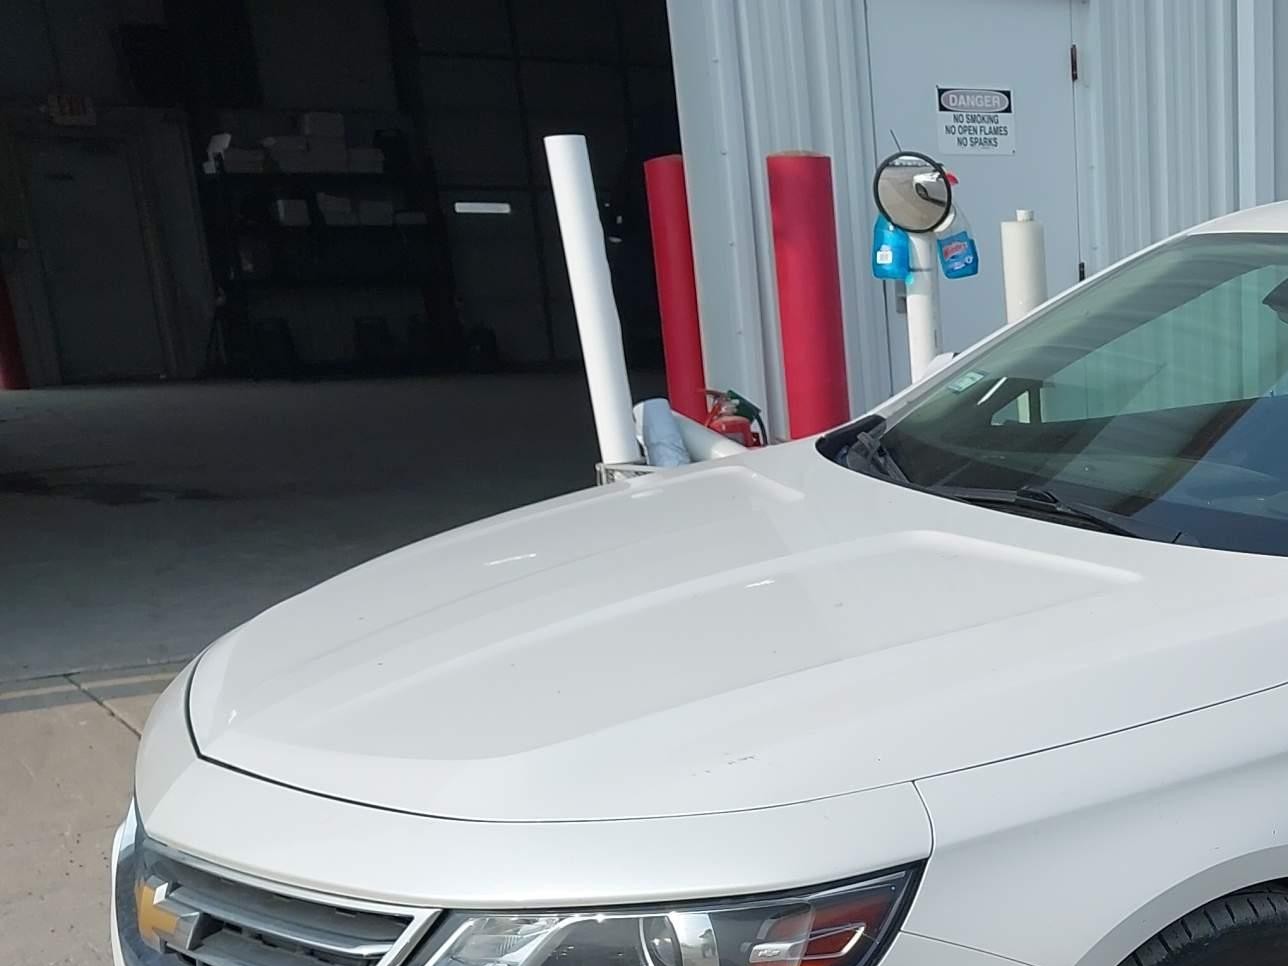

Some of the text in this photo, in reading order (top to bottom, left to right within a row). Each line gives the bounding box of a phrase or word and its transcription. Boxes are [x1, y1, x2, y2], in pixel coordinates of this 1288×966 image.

[949, 94, 1001, 108] DANGER
[953, 114, 999, 125] NO SMOKING
[945, 125, 1008, 136] NO OPEN FLAMES
[957, 137, 998, 148] NO SPARKS
